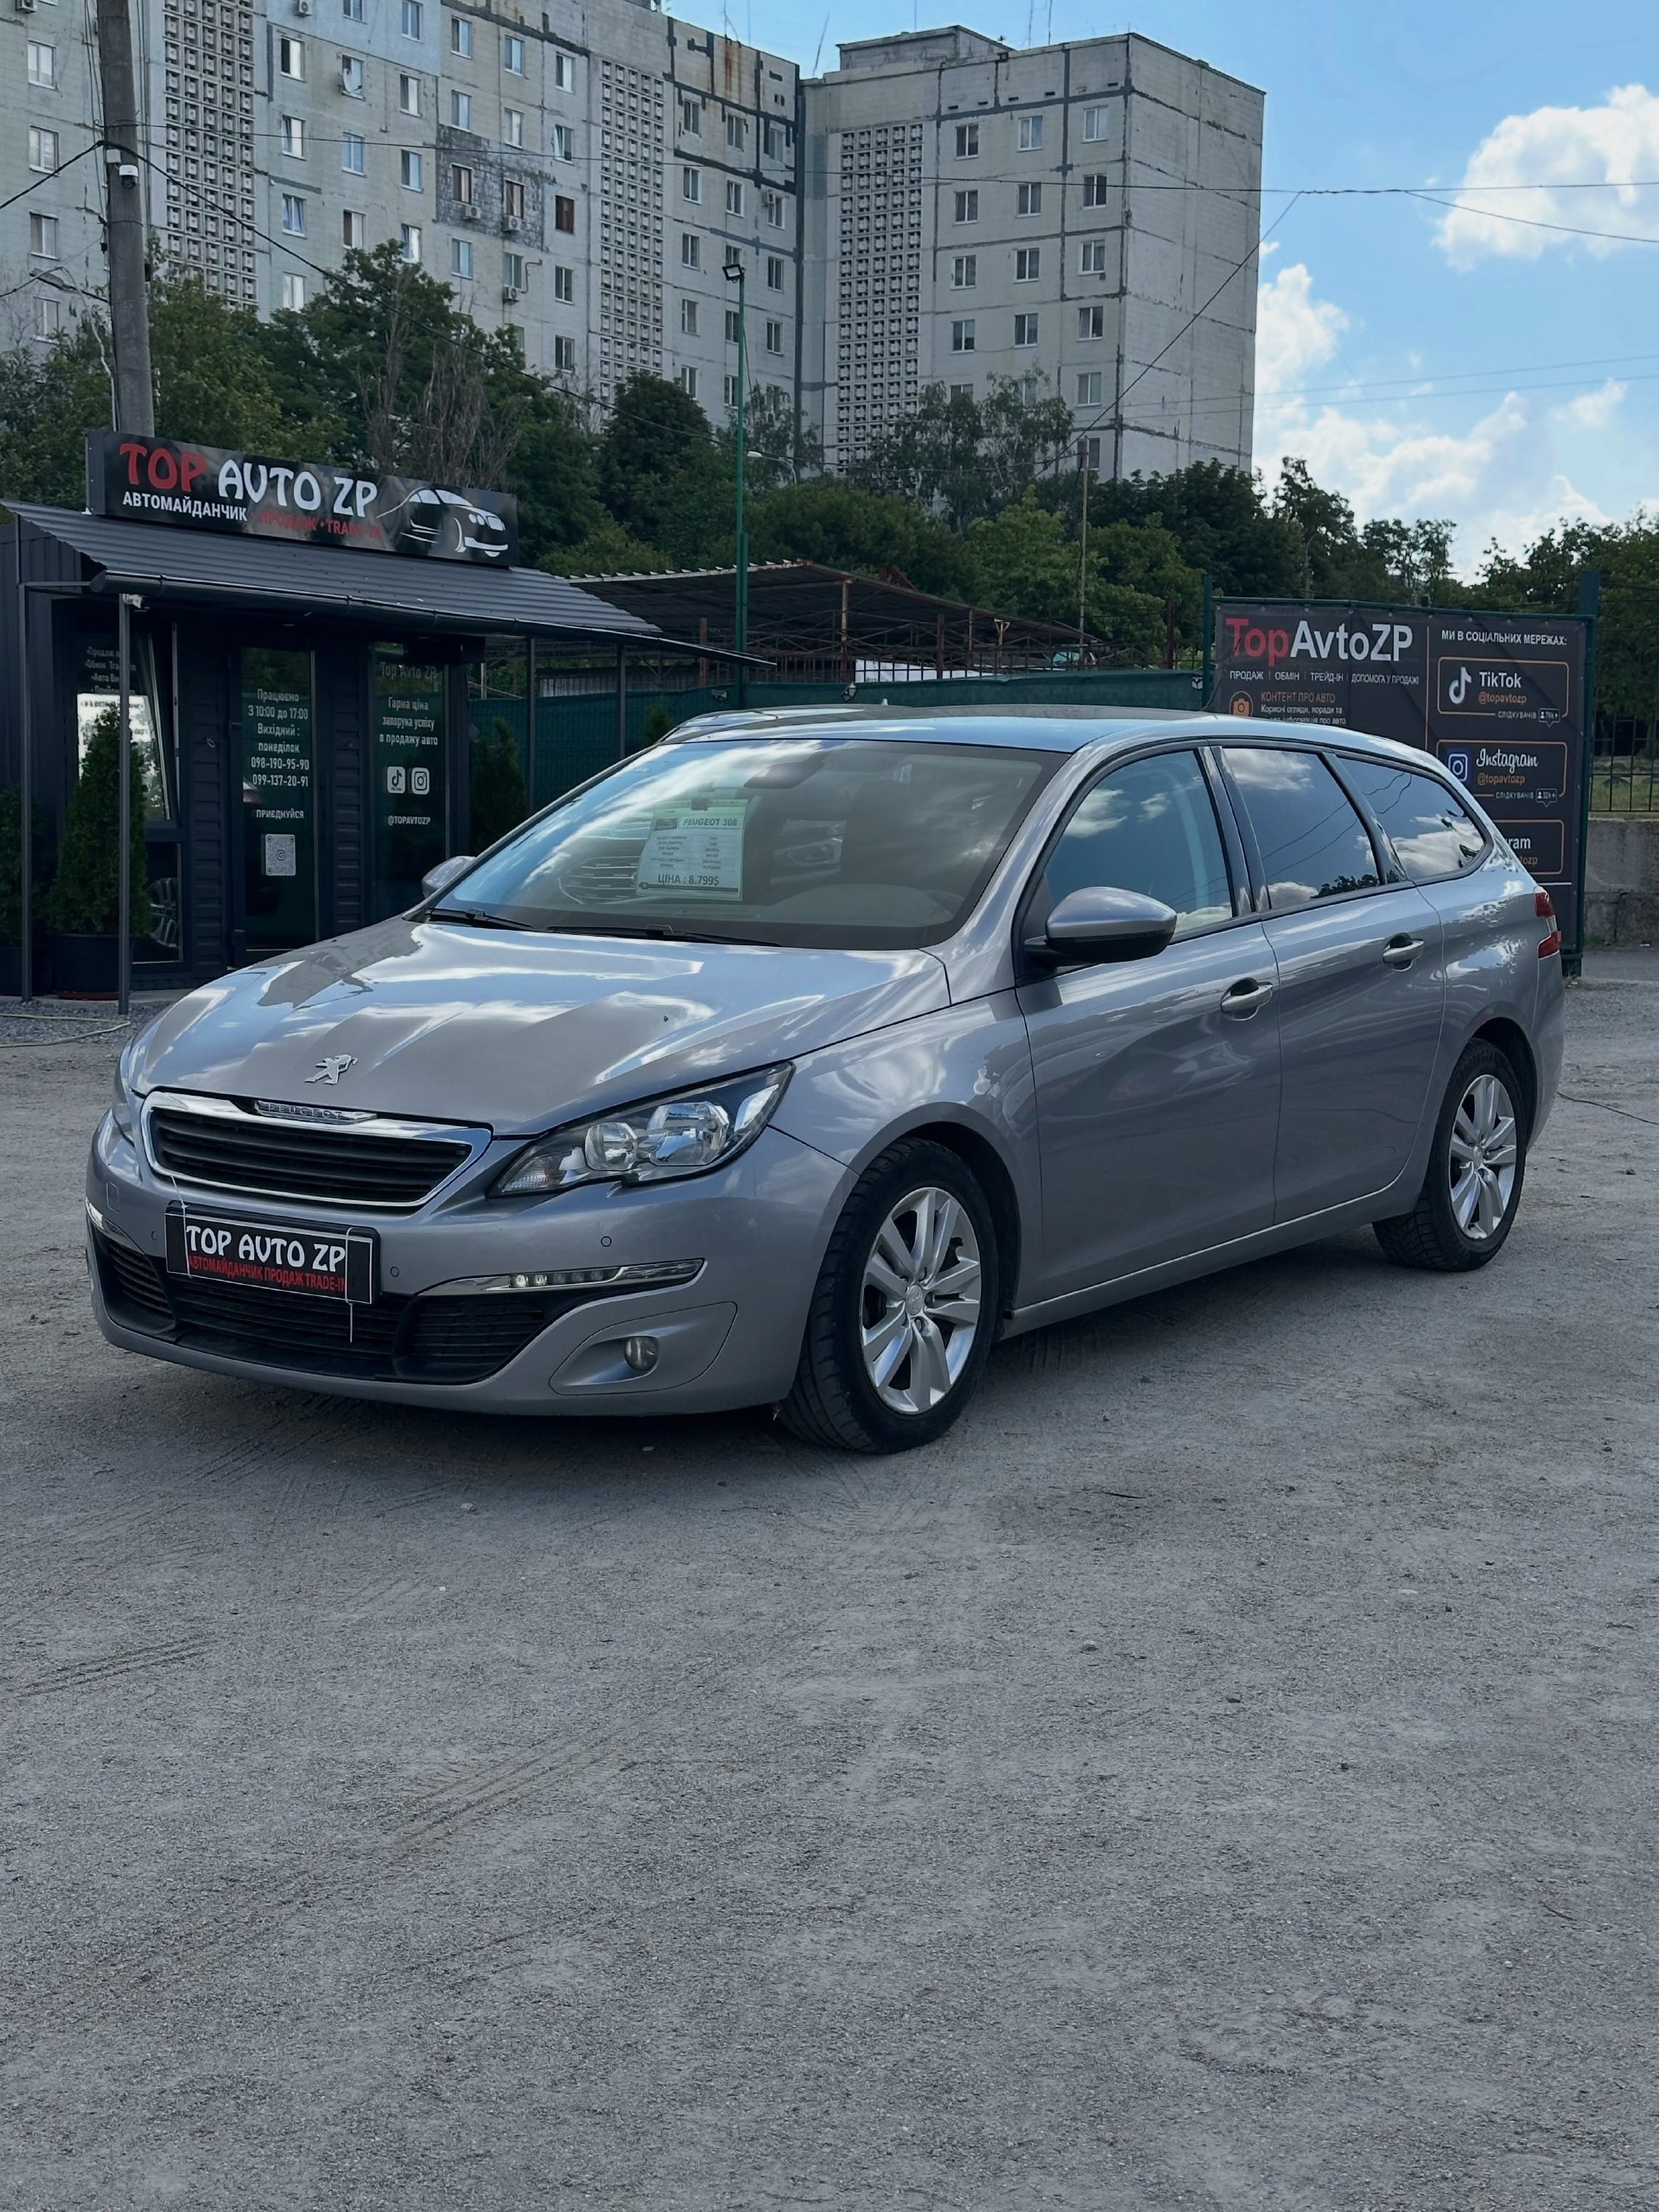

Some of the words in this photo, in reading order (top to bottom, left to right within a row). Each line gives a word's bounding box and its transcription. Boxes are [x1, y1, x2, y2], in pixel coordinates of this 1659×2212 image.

[119, 443, 207, 493] TOP
[218, 459, 321, 512] AVTO
[333, 475, 378, 518] ZP
[122, 491, 248, 521] АВТОМАЙДАНЧИК
[1225, 618, 1414, 668] TopAvtoZP
[1441, 630, 1455, 640] МИ
[1457, 631, 1464, 641] В
[1465, 631, 1522, 644] СОЦІАЛЬНИХ
[1523, 633, 1567, 645] МЕРЕЖАХ:
[1230, 670, 1264, 681] ПРОДАЖ
[1274, 671, 1300, 681] ОБМІН
[1310, 671, 1344, 683] ТРЕЙД-ІН
[1351, 673, 1386, 684] ДОПОМОГА
[1386, 674, 1391, 684] У
[1478, 671, 1522, 689] TikTok
[257, 688, 300, 703] Працюємо
[1261, 691, 1297, 702] КОНТЕНТ
[1298, 692, 1314, 703] ПРО
[1315, 693, 1336, 703] АВТО
[1478, 691, 1527, 705] @topavtozp
[388, 696, 410, 711] Гарна
[411, 698, 429, 712] ціна
[255, 705, 276, 718] 10:00
[276, 709, 288, 720] до
[289, 707, 308, 720] 17:00
[257, 722, 296, 737] Вихідний
[257, 741, 300, 754] понеділок
[378, 734, 385, 743] в
[385, 734, 420, 747] продажу
[421, 735, 439, 746] авто
[251, 757, 310, 771] 098-190-95-90
[1476, 747, 1539, 774] Instagram
[251, 774, 309, 787] 099-137-20-91
[1477, 772, 1526, 785] @topavtozp
[256, 808, 304, 820] ПРИЄДНУЙСЯ
[387, 815, 431, 826] @TOPAVTOZP
[683, 817, 721, 827] PEUGEOT
[721, 818, 738, 827] 308
[658, 873, 681, 886] ЦІНА
[688, 874, 720, 887] 8.799$
[268, 1103, 342, 1120] PEUGEOT
[186, 1224, 232, 1256] TOP
[238, 1233, 305, 1268] AVTO
[312, 1243, 346, 1273] ZP
[188, 1255, 264, 1281] АВТОМАЙДАНЧИК
[264, 1267, 303, 1287] ПРОДАЖ
